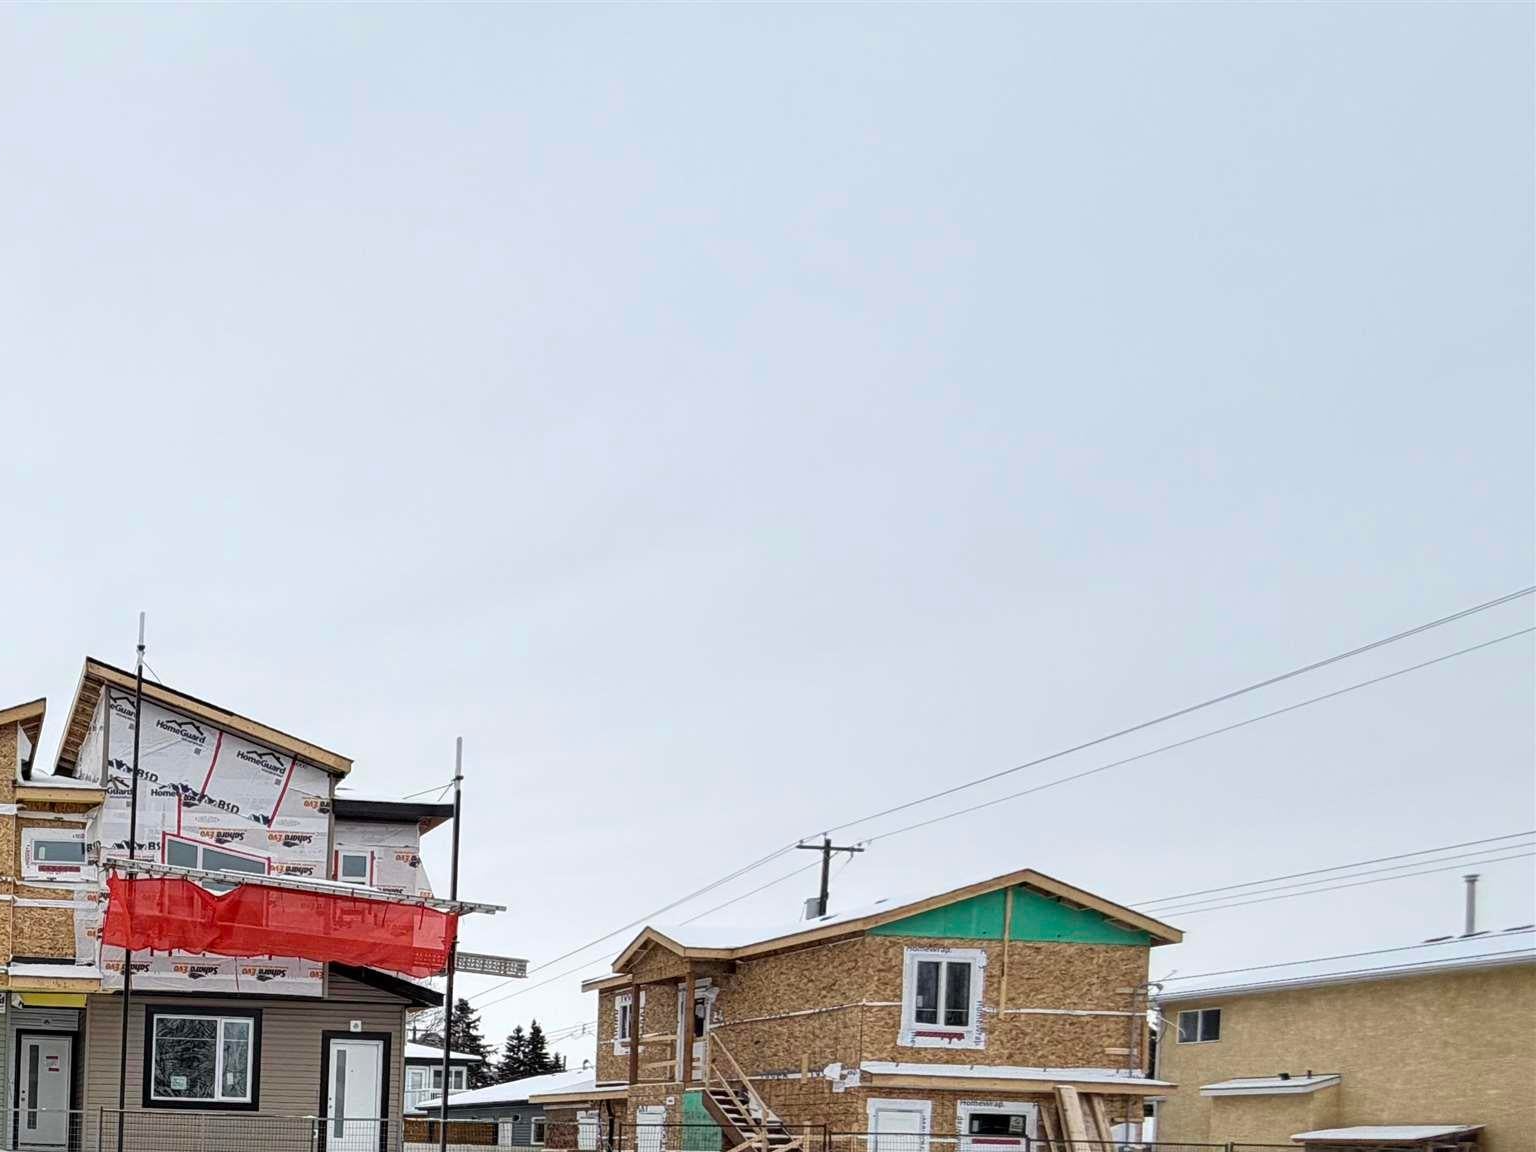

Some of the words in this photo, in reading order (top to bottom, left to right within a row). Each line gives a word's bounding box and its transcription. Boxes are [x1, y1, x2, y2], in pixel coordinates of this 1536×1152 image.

[156, 719, 206, 744] HomeGuard
[236, 750, 286, 774] HomeGuard
[218, 801, 240, 814] BSD
[200, 830, 215, 839] Evo
[216, 831, 246, 841] Sahara
[268, 833, 283, 842] Evo
[284, 834, 313, 843] Sahara
[148, 842, 161, 850] BS
[286, 866, 314, 876] Sahara
[105, 963, 120, 971] Evo
[174, 965, 188, 974] Evo
[190, 966, 219, 975] Sahara
[242, 968, 256, 976] Evo
[258, 968, 287, 977] Sahara
